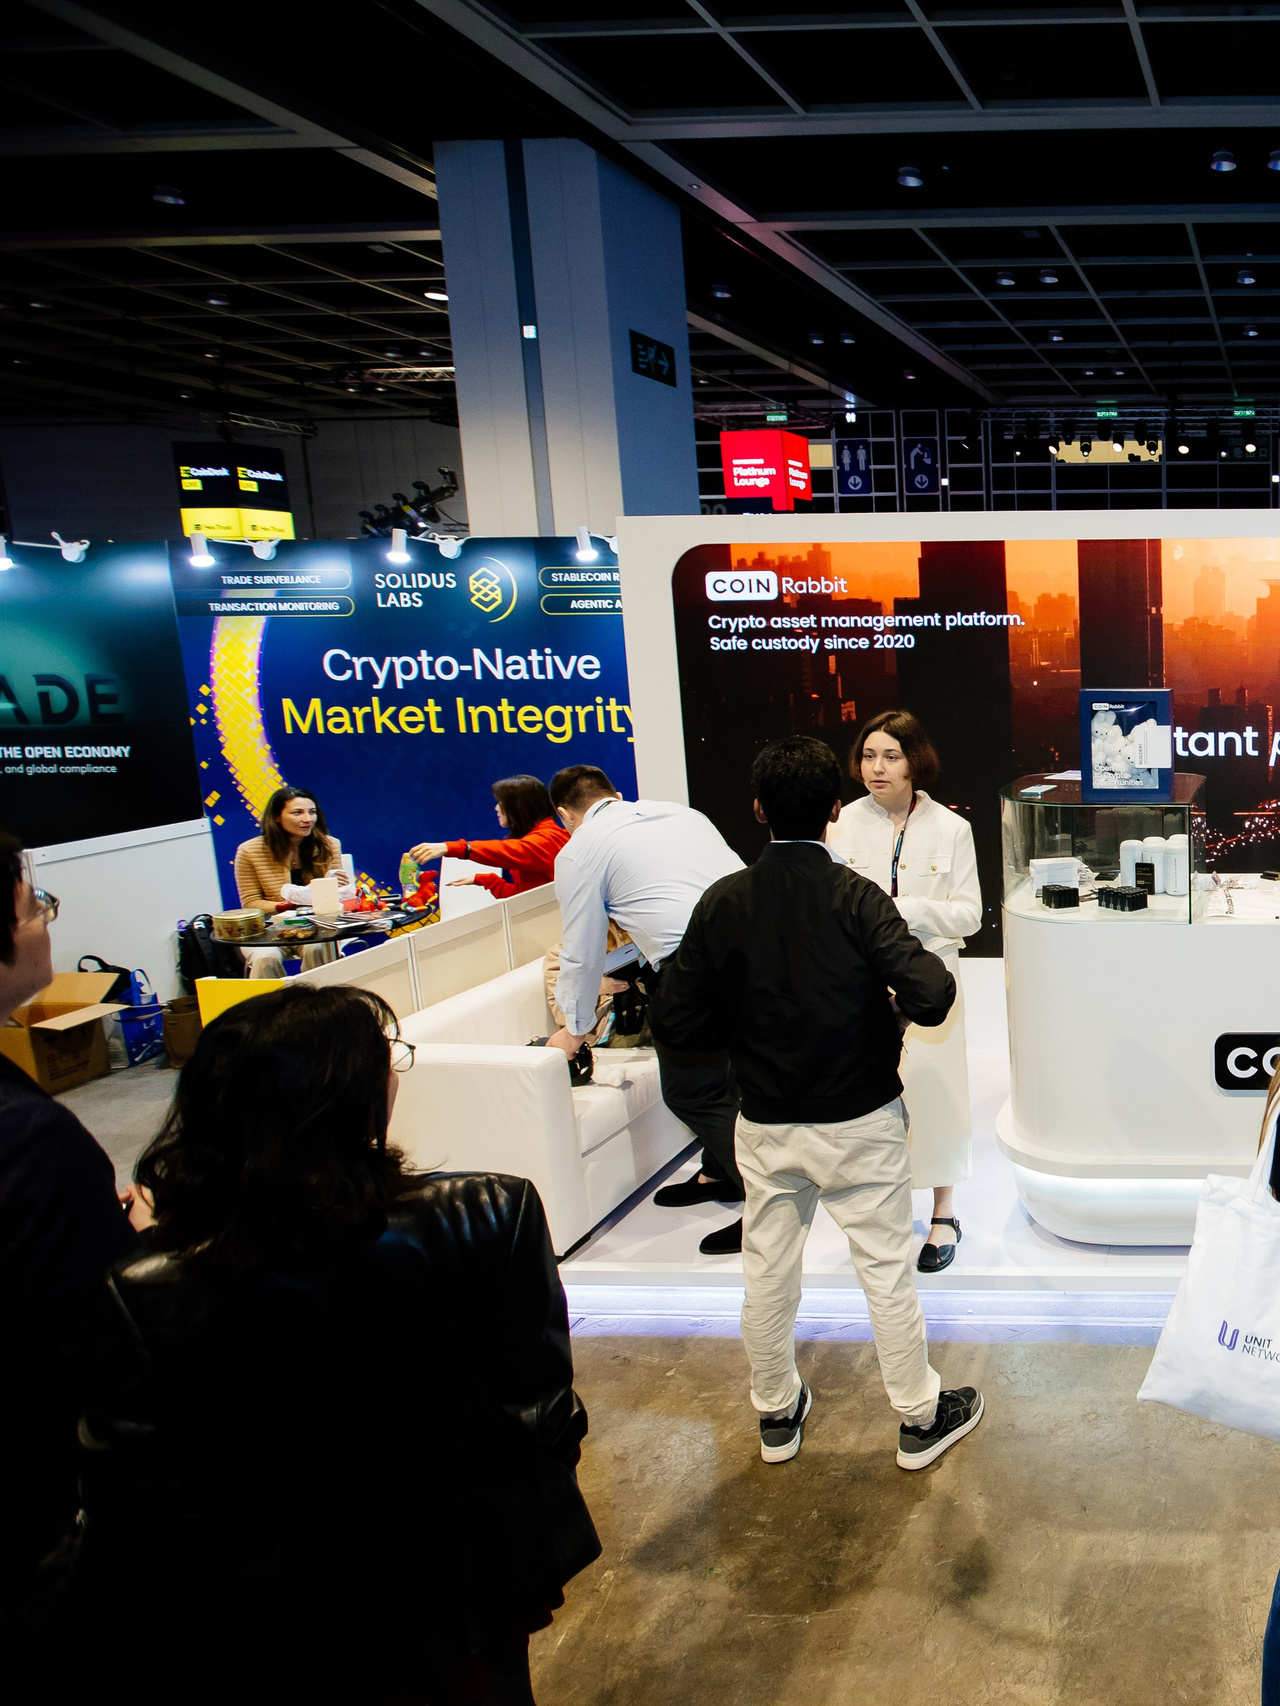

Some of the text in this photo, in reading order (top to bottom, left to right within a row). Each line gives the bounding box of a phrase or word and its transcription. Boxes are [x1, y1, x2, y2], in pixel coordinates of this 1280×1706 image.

[732, 467, 777, 476] Platinum
[733, 477, 770, 488] Lounge
[221, 575, 322, 585] TRADE SURVEILLANCE
[374, 572, 457, 589] SOLIDUS
[551, 572, 612, 582] STABLECOIN
[712, 576, 849, 594] COIN Rabbit
[208, 601, 340, 612] TRANSACTION MONITORING
[376, 592, 424, 608] LABS
[570, 599, 614, 609] AGENTIC
[708, 611, 1026, 633] Crypto asset management platform.
[709, 634, 916, 654] Safe custody since 2020
[323, 647, 601, 689] Crypto-Native
[281, 696, 445, 734] Market
[1173, 725, 1259, 757] tant
[0, 746, 131, 758] THE OPEN ECONOMY
[4, 764, 118, 776] and global compliance
[1244, 1335, 1273, 1349] UNIT
